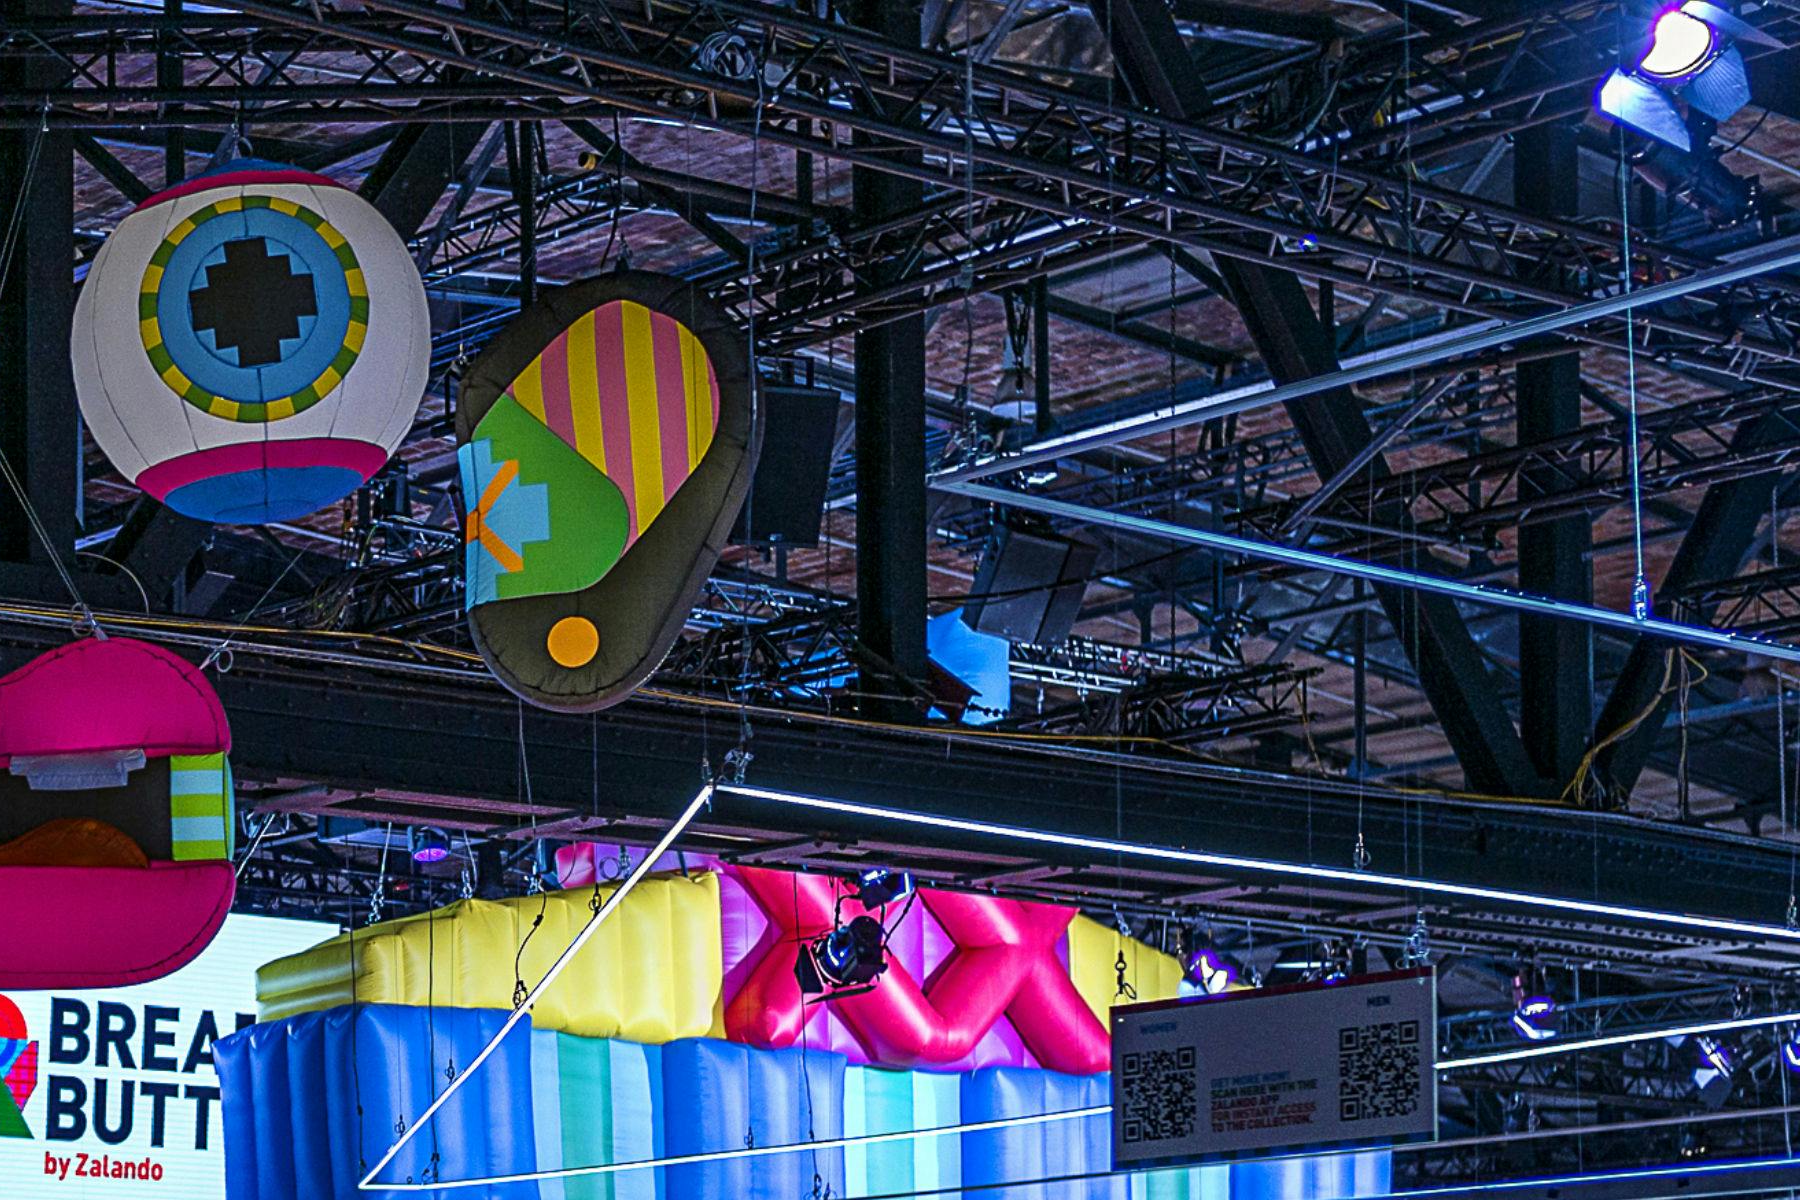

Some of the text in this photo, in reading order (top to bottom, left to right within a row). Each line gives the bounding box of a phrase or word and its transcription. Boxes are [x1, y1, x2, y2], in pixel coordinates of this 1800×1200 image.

[49, 996, 256, 1074] BREA
[1210, 1078, 1318, 1098] SCAN HERE WITH THE
[1211, 1093, 1280, 1110] ZALANDO APP
[1211, 1101, 1317, 1121] FOR INSTANT ACCESS
[1212, 1122, 1225, 1133] TO
[1226, 1119, 1246, 1131] THE
[44, 1152, 163, 1181] by Zalando
